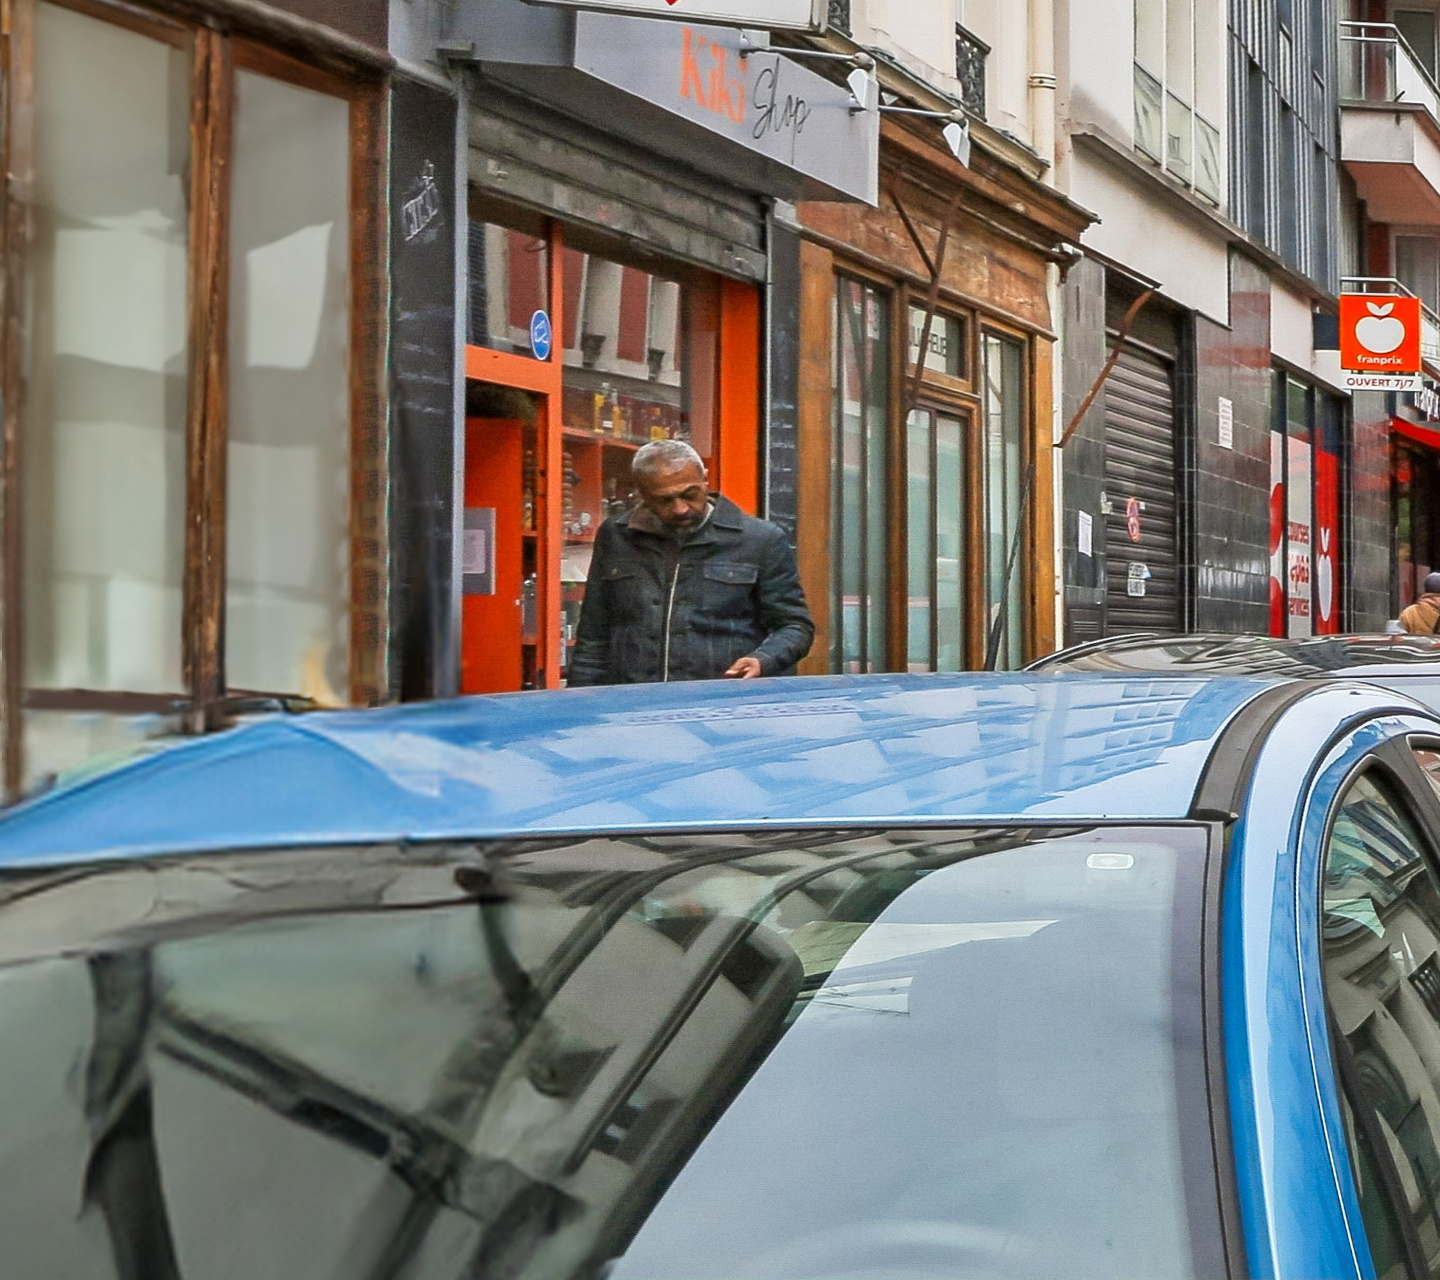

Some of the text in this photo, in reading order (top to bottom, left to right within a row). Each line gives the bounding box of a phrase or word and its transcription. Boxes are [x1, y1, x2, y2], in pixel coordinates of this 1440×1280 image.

[752, 57, 811, 165] Shop
[1357, 354, 1403, 365] franprix
[1347, 377, 1391, 387] OUVERT
